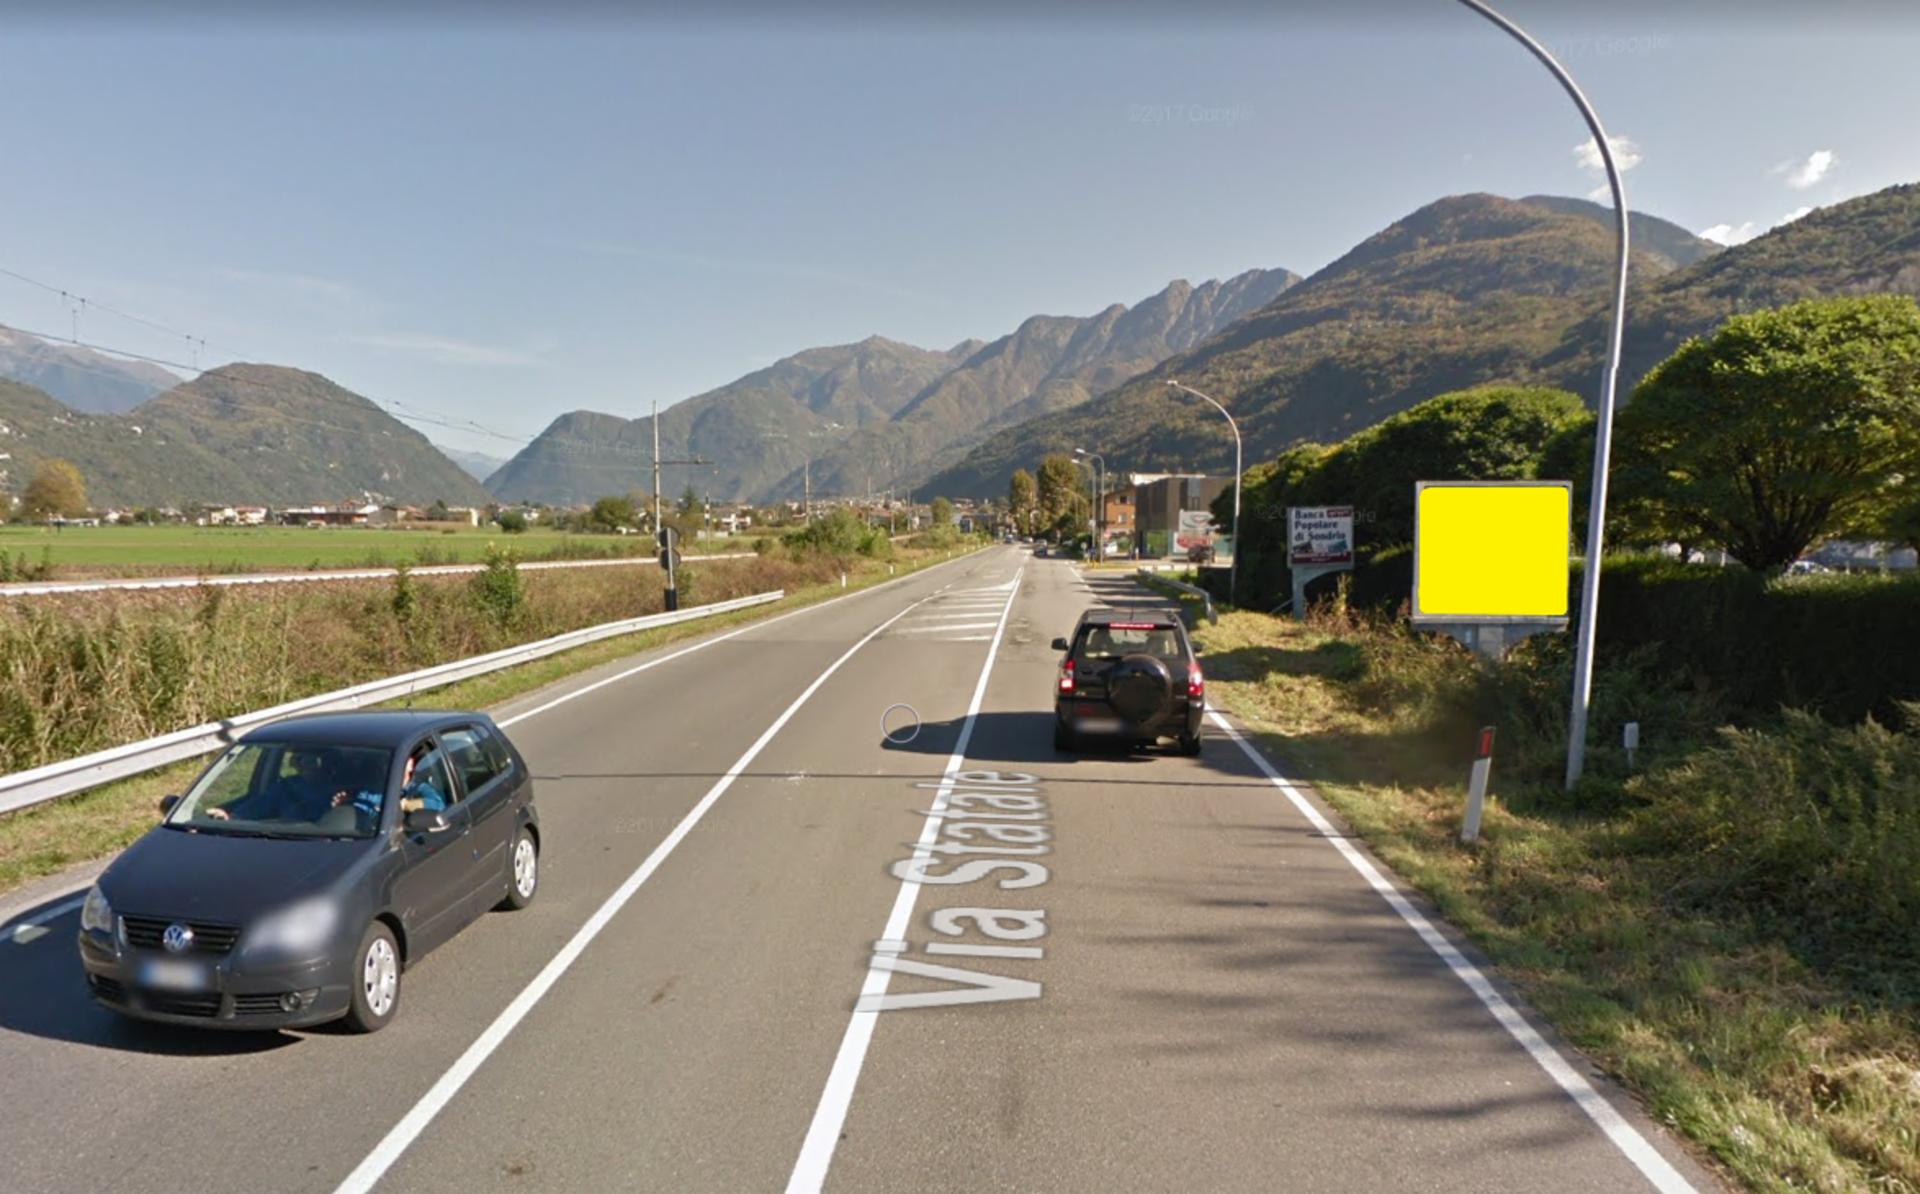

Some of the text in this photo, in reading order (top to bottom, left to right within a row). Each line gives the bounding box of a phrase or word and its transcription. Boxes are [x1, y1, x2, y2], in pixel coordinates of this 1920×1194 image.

[1295, 509, 1324, 519] Banca
[1295, 520, 1338, 531] Popolare
[1295, 530, 1346, 541] di Sondrio
